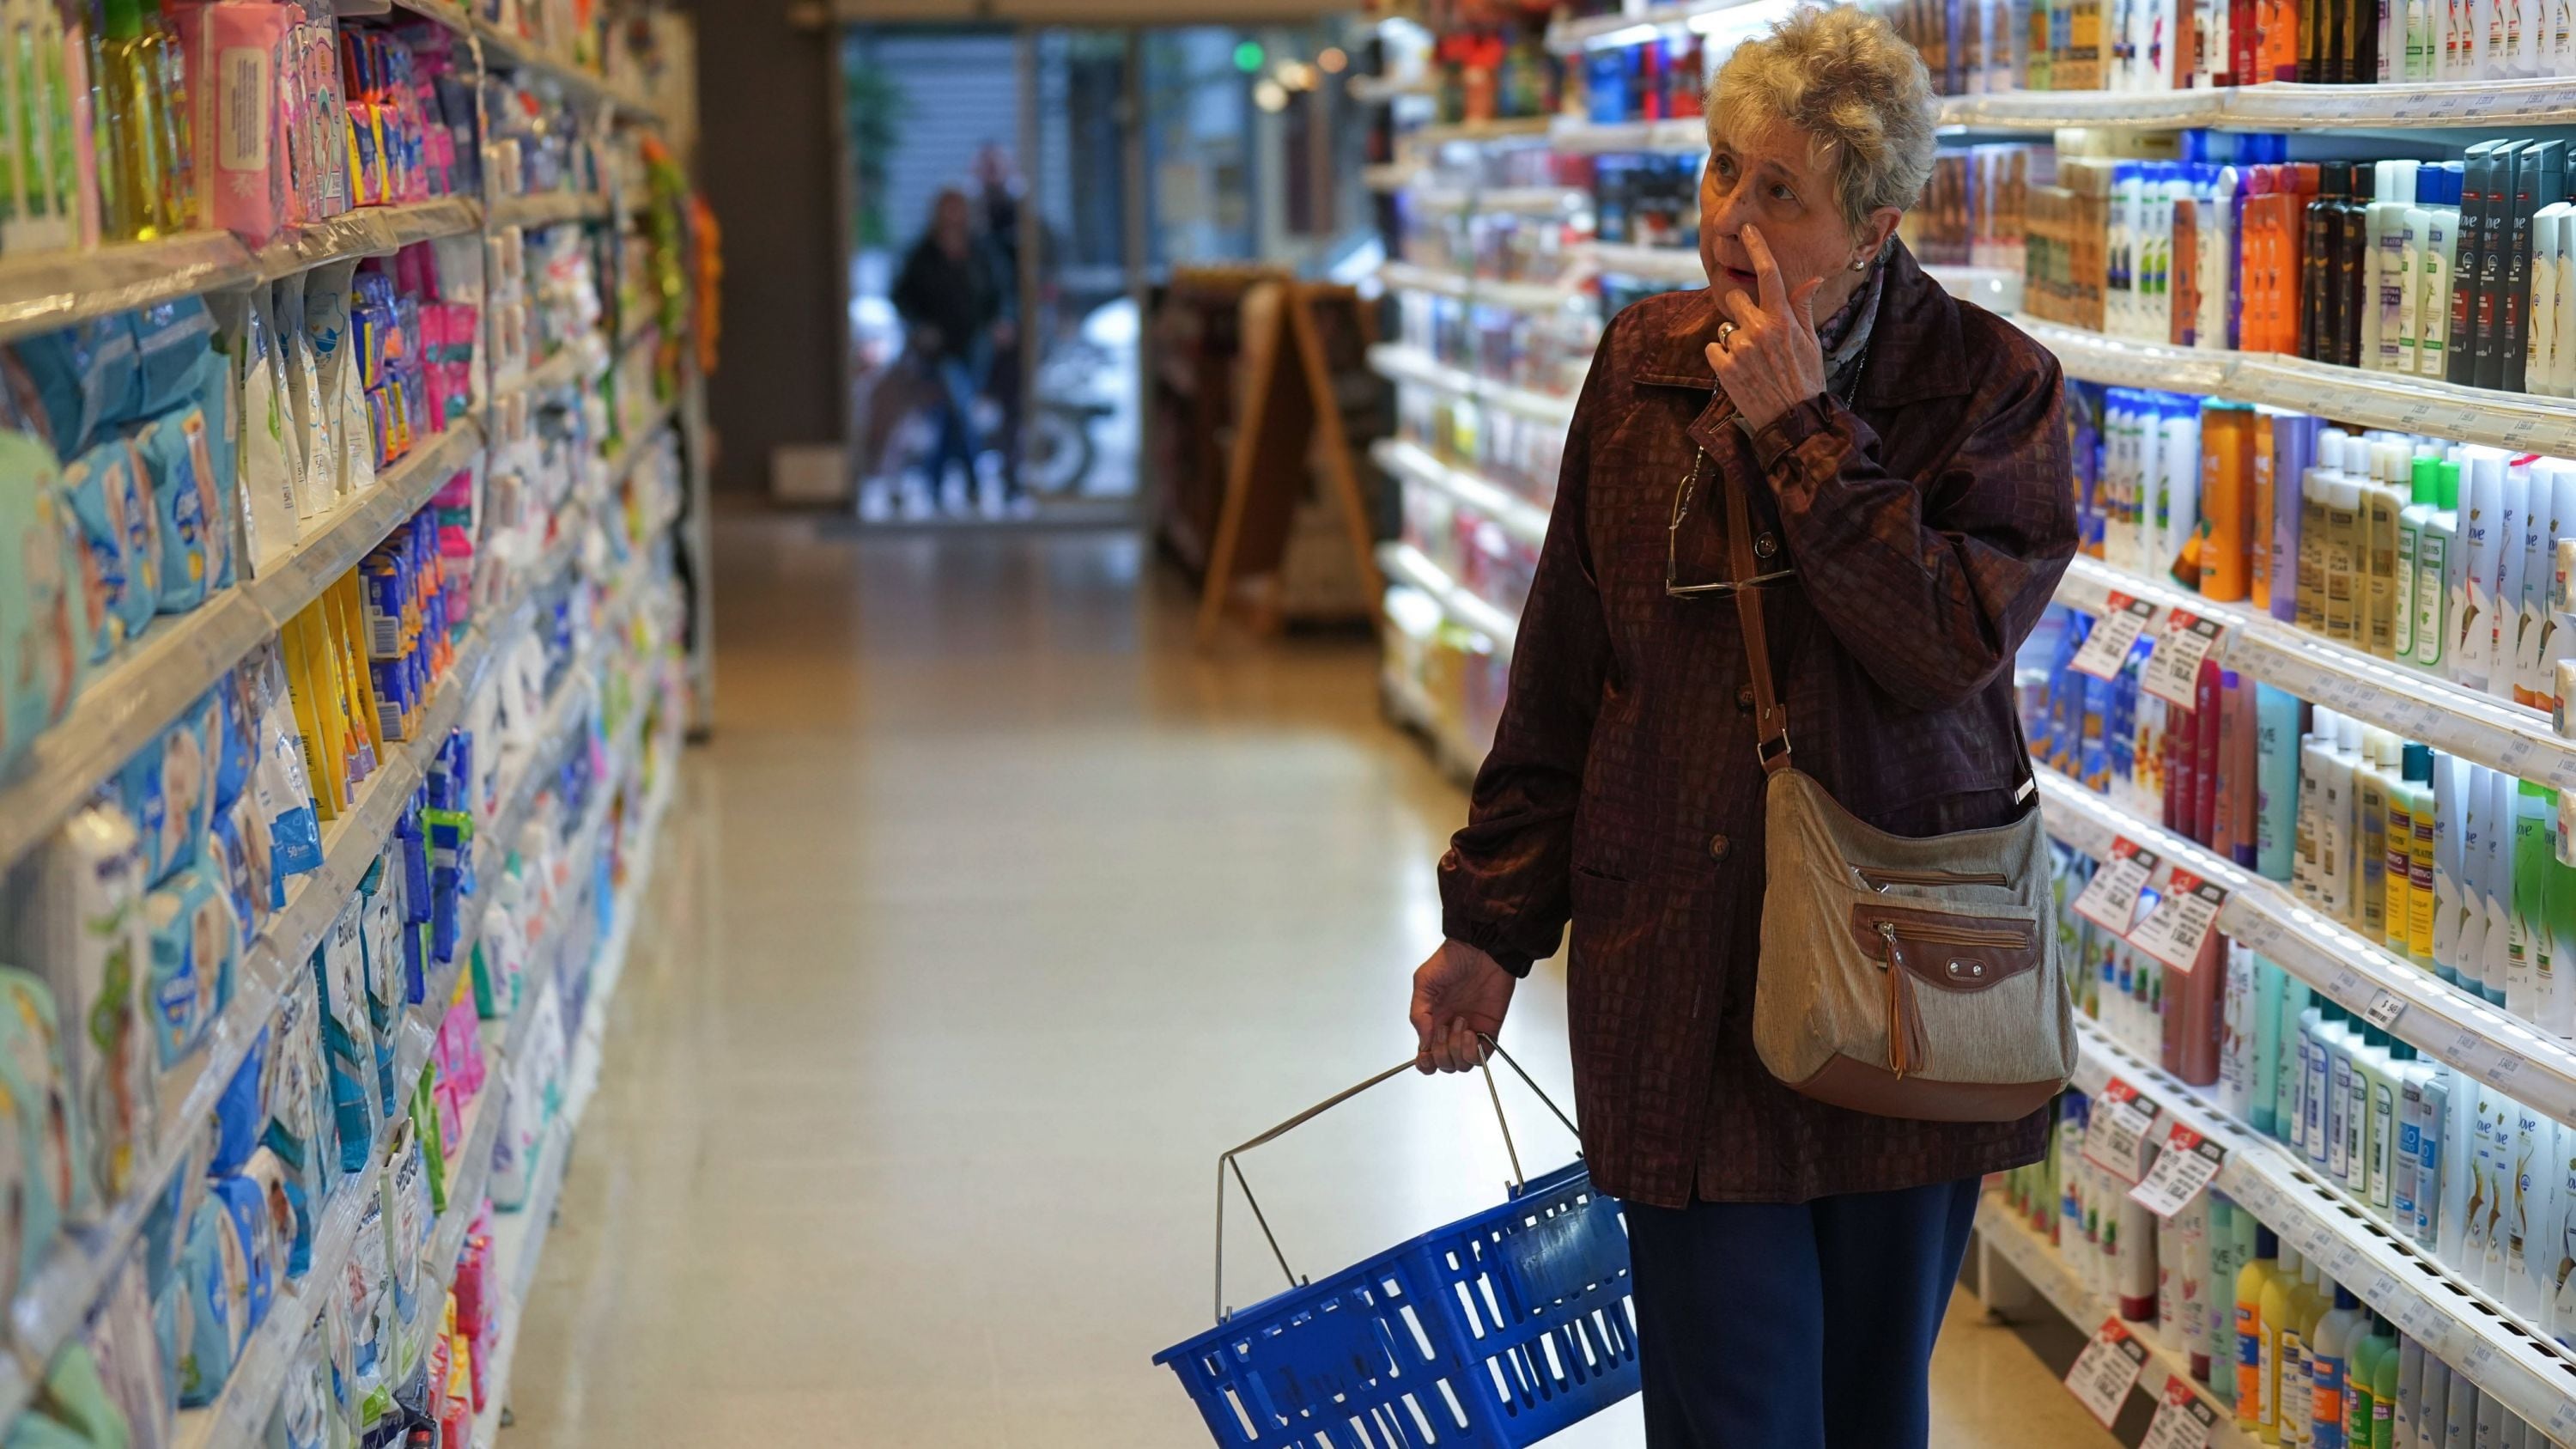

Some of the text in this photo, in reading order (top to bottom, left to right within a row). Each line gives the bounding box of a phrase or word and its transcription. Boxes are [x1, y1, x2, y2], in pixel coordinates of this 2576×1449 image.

[2459, 215, 2477, 228] ove
[2485, 216, 2500, 229] ove
[2513, 217, 2526, 229] ove
[2468, 526, 2485, 541] ove
[2525, 533, 2537, 547] ove
[2517, 824, 2532, 837] ove
[2476, 1120, 2492, 1134] ove
[2519, 1116, 2536, 1132] ove
[2495, 1131, 2508, 1145] ove
